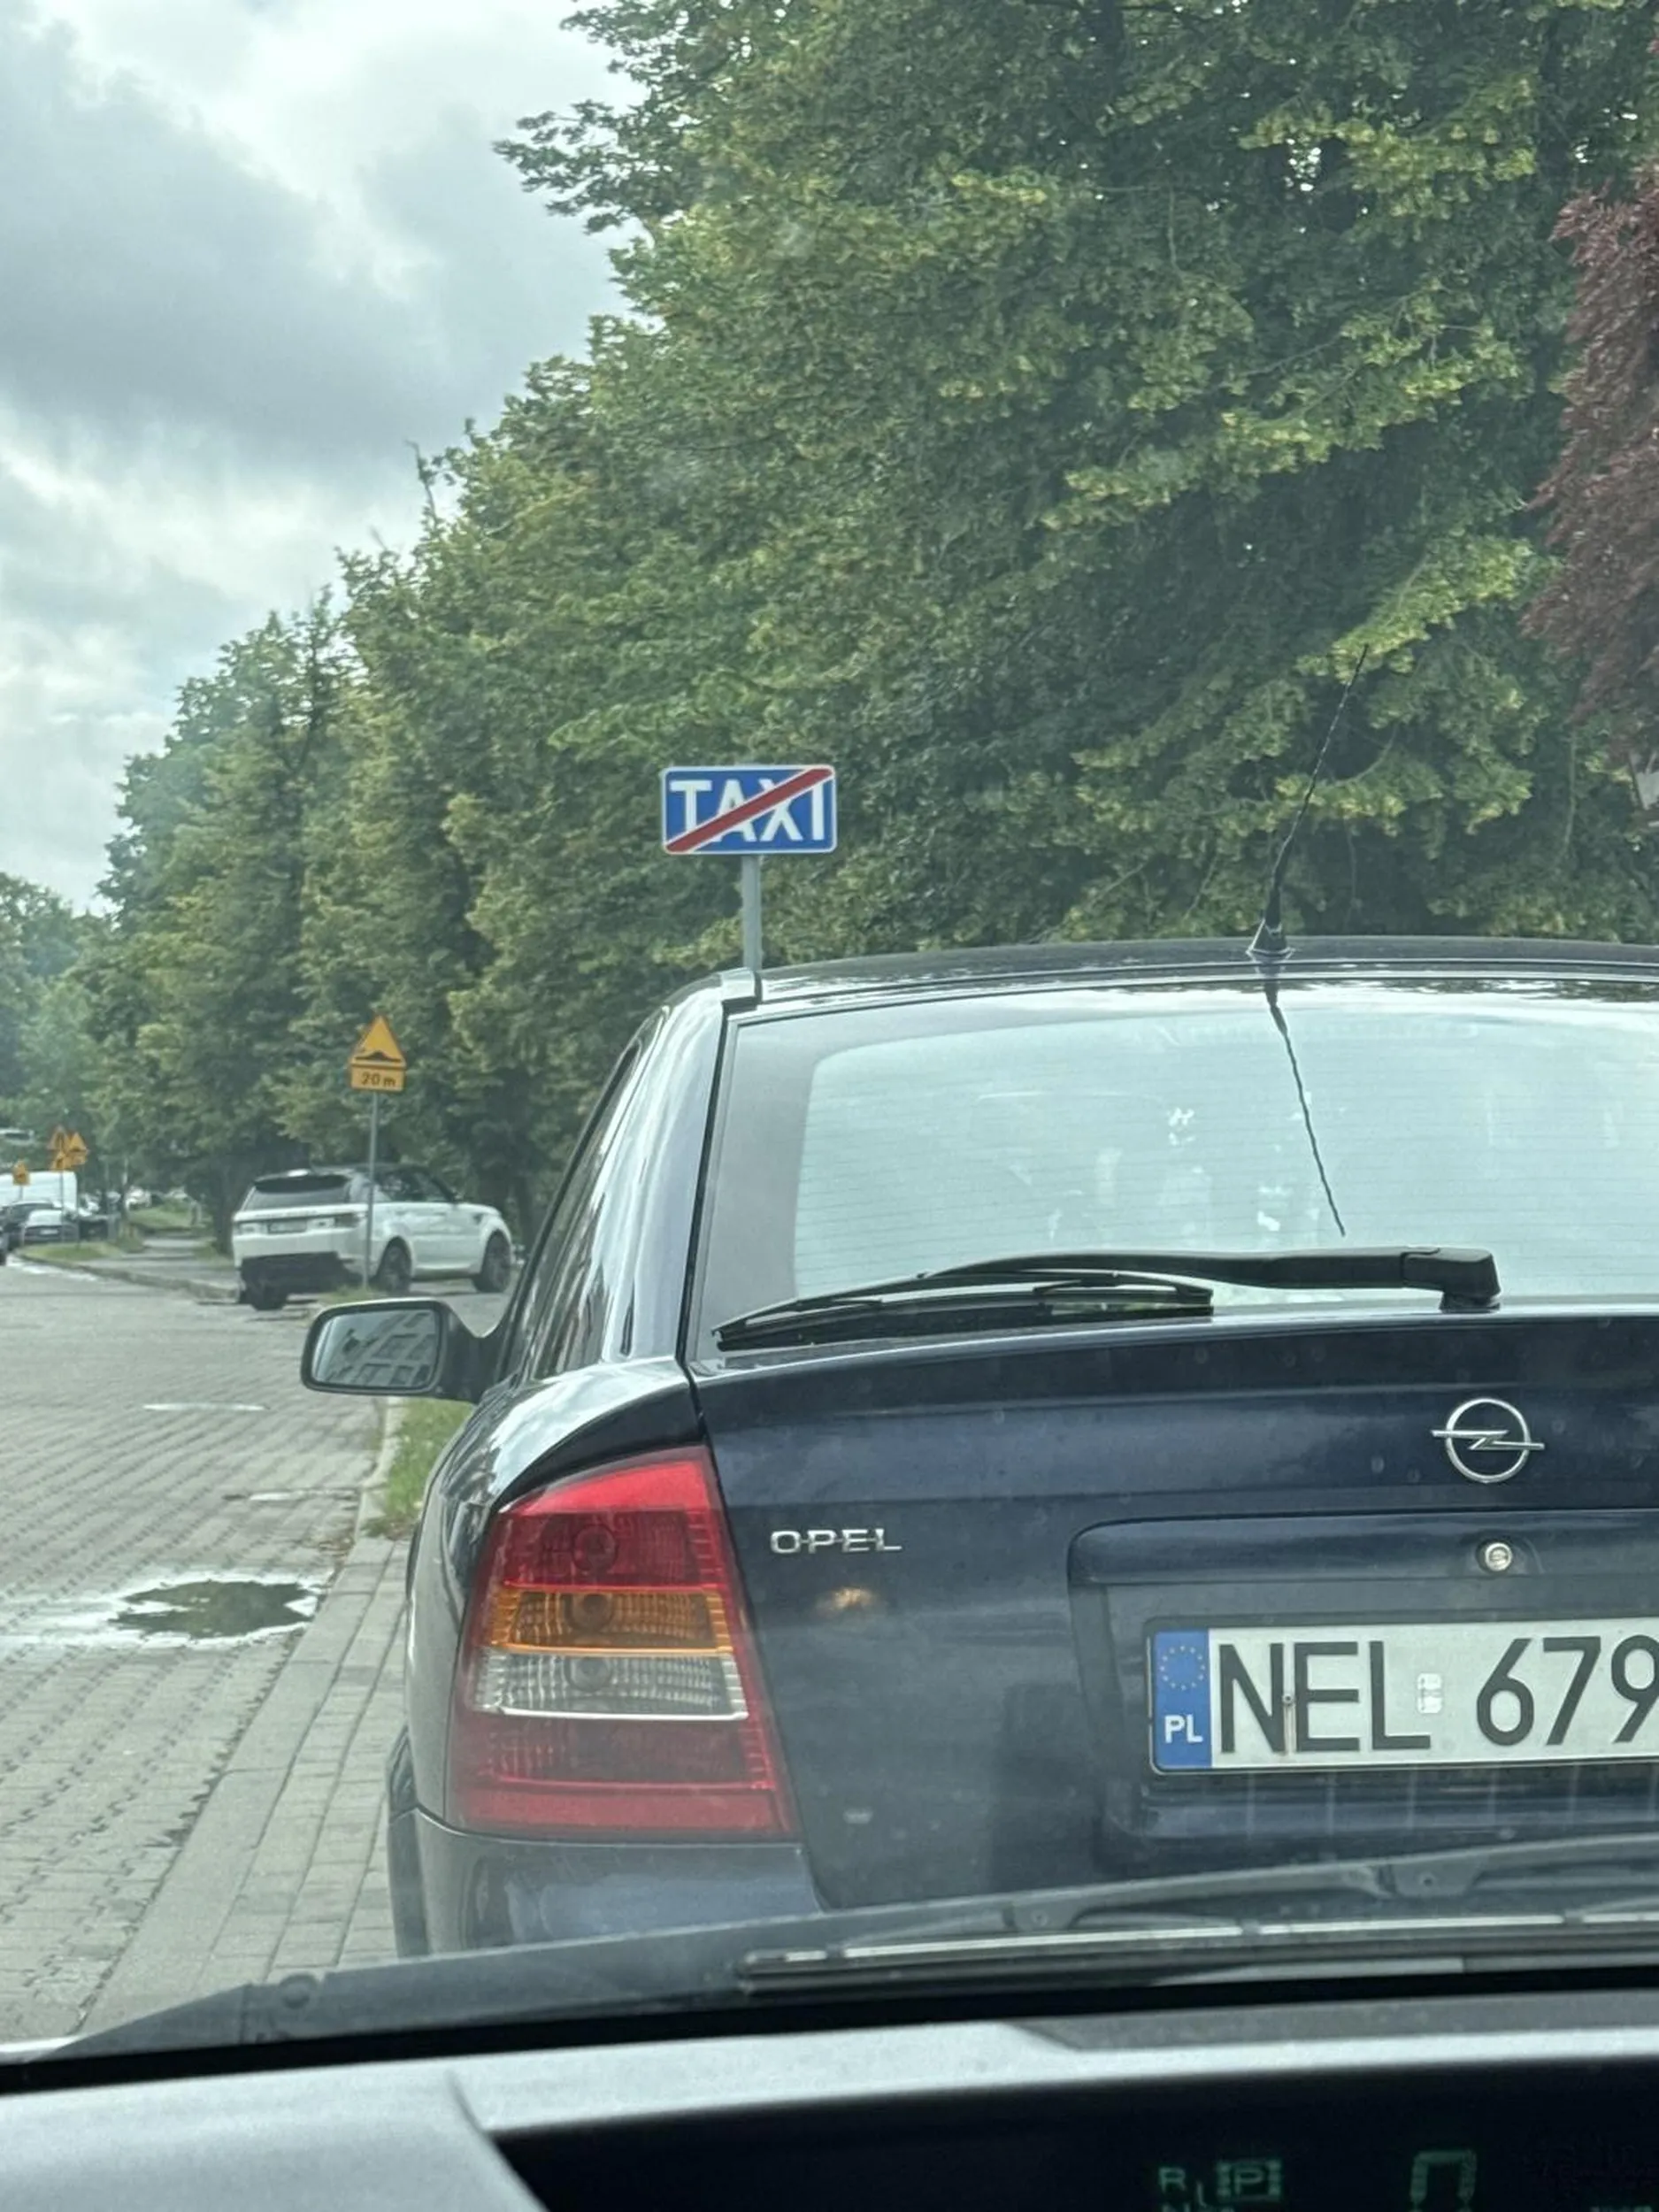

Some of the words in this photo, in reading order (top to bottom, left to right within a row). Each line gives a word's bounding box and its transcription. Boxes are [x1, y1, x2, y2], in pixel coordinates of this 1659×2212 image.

[670, 778, 825, 842] TAXI
[362, 1071, 380, 1087] 20
[770, 1527, 902, 1555] OPEL
[1218, 1640, 1431, 1754] NEL
[1476, 1634, 1659, 1747] 679
[1164, 1714, 1203, 1744] PL
